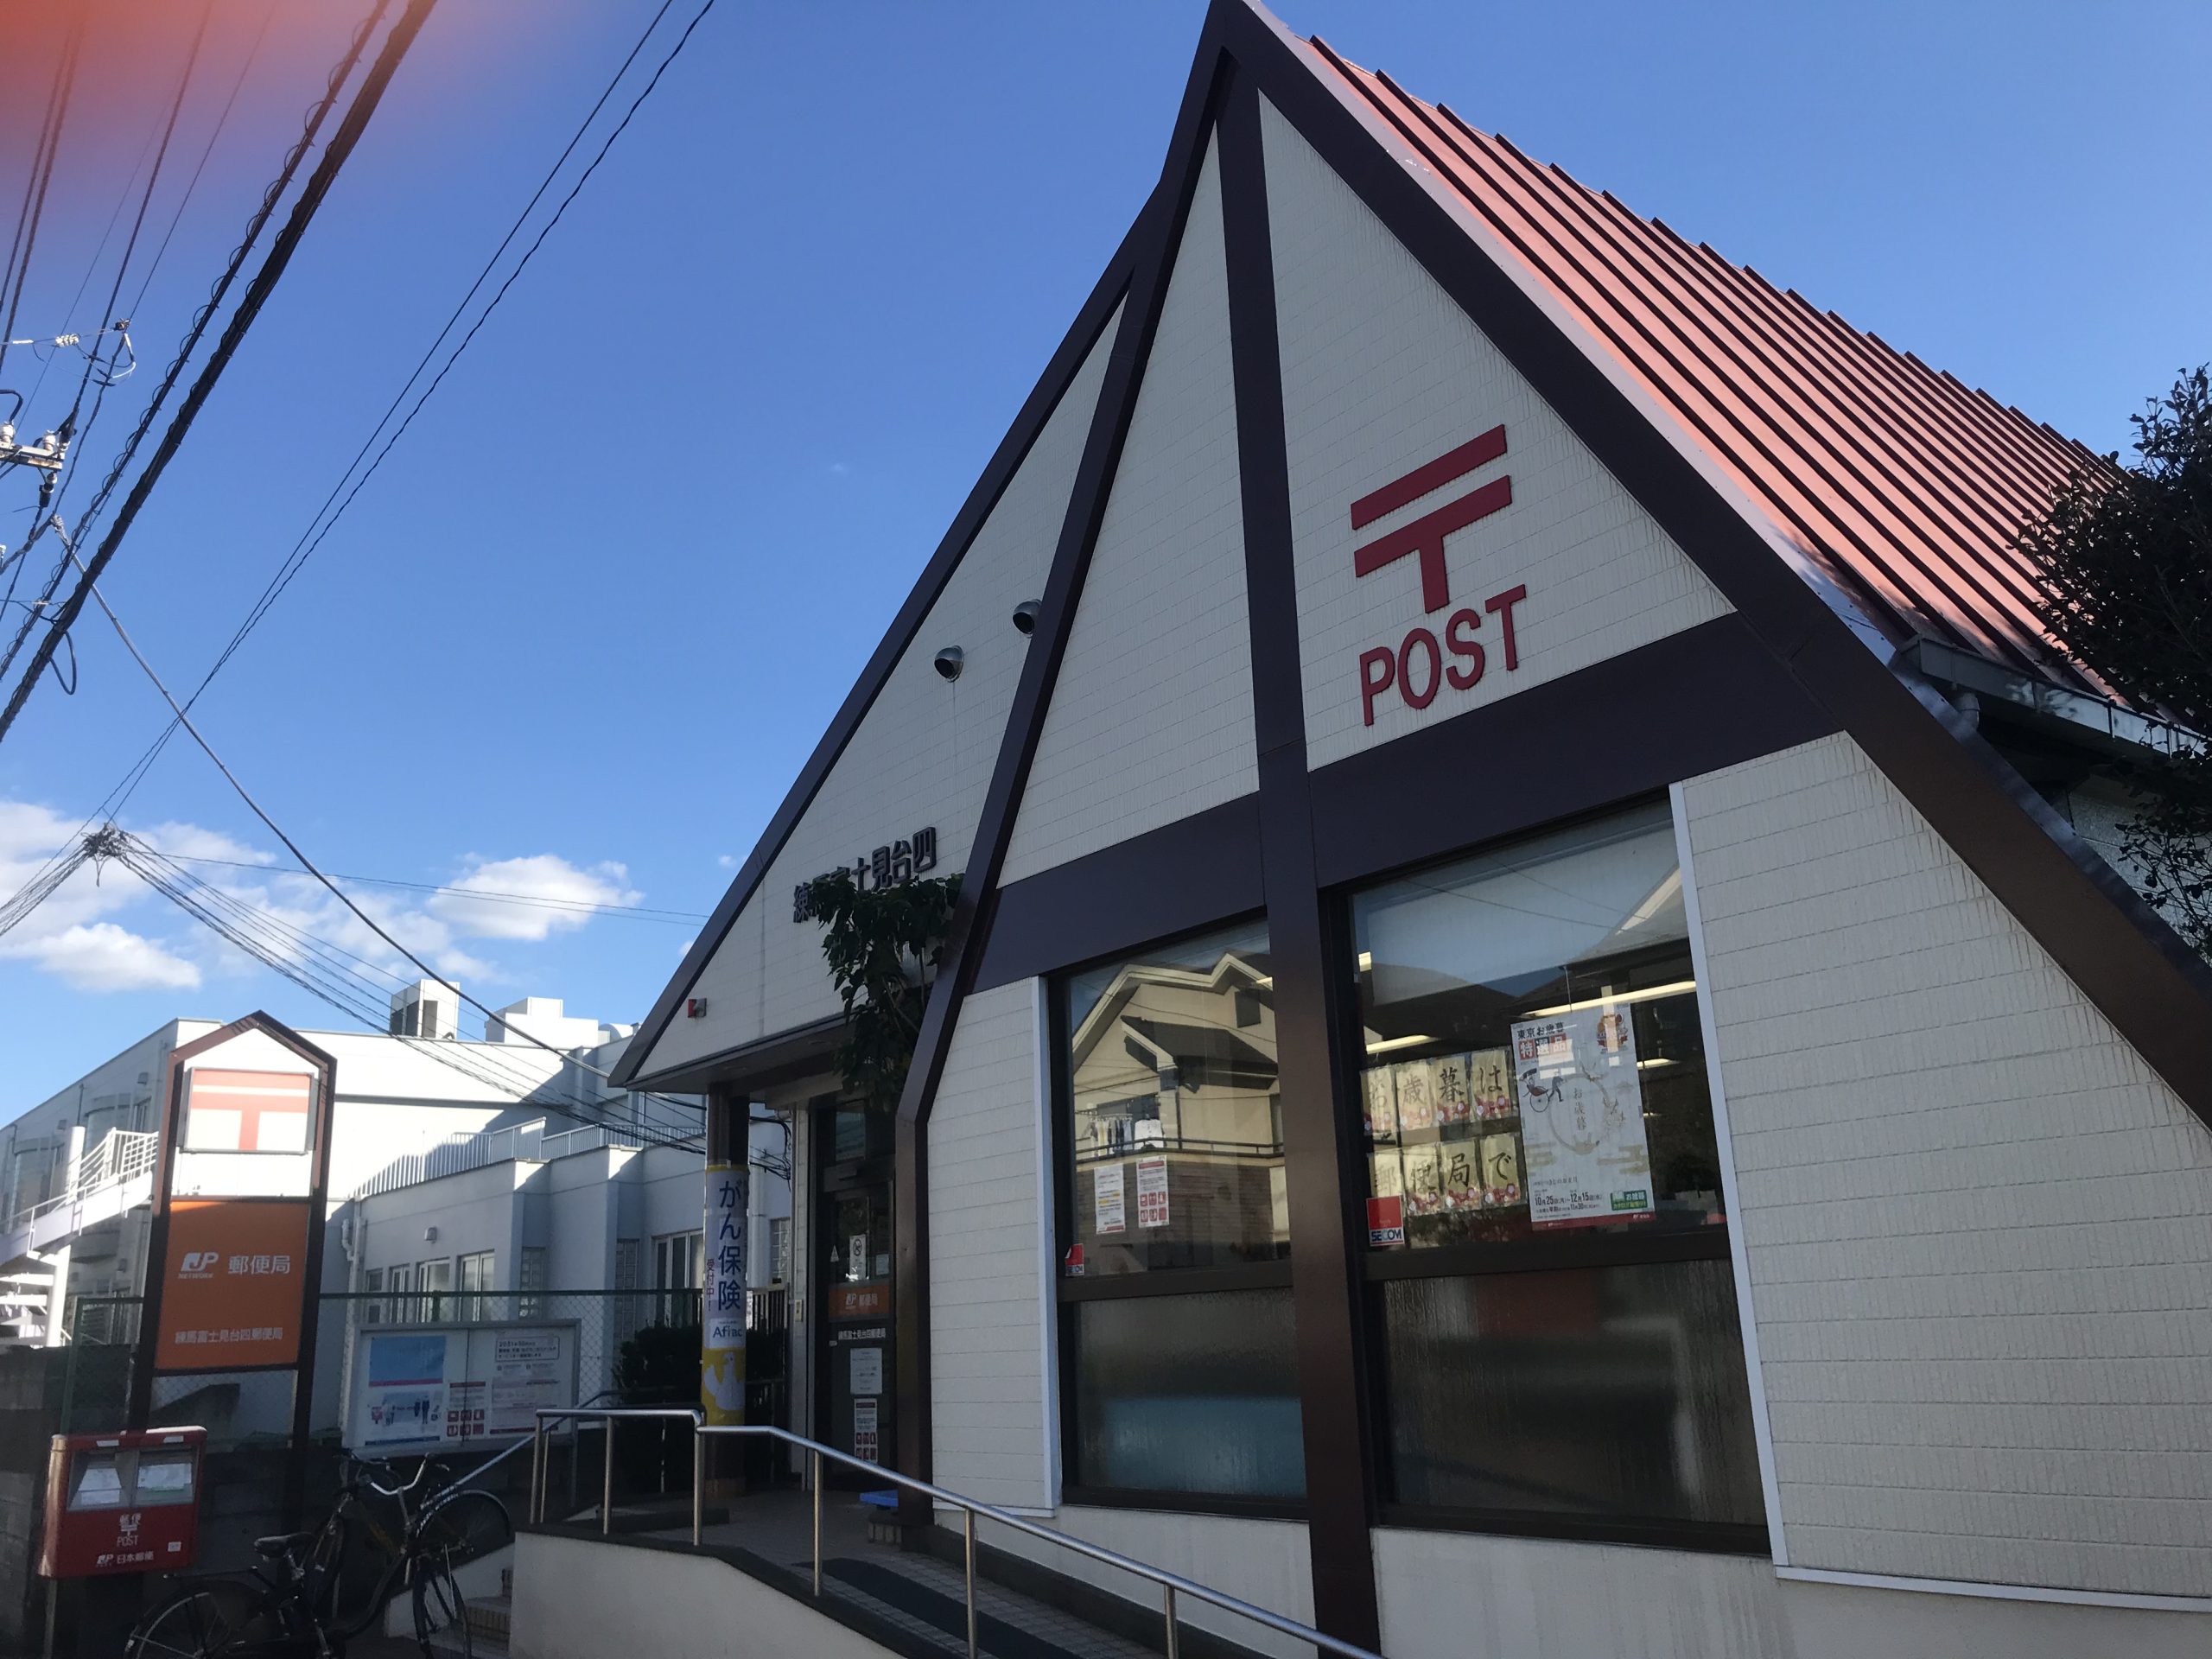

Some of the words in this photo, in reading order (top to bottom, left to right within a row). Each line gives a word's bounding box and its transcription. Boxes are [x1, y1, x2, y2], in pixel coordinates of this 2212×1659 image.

[1359, 584, 1527, 727] POST
[793, 826, 937, 923] 練士見台四
[1521, 1036, 1567, 1058] 特選品
[1371, 1229, 1402, 1242] SECOM
[719, 1180, 741, 1312] がん保険
[228, 1255, 291, 1274] 郵便局
[712, 1325, 743, 1338] Aflac
[117, 1535, 138, 1548] POST
